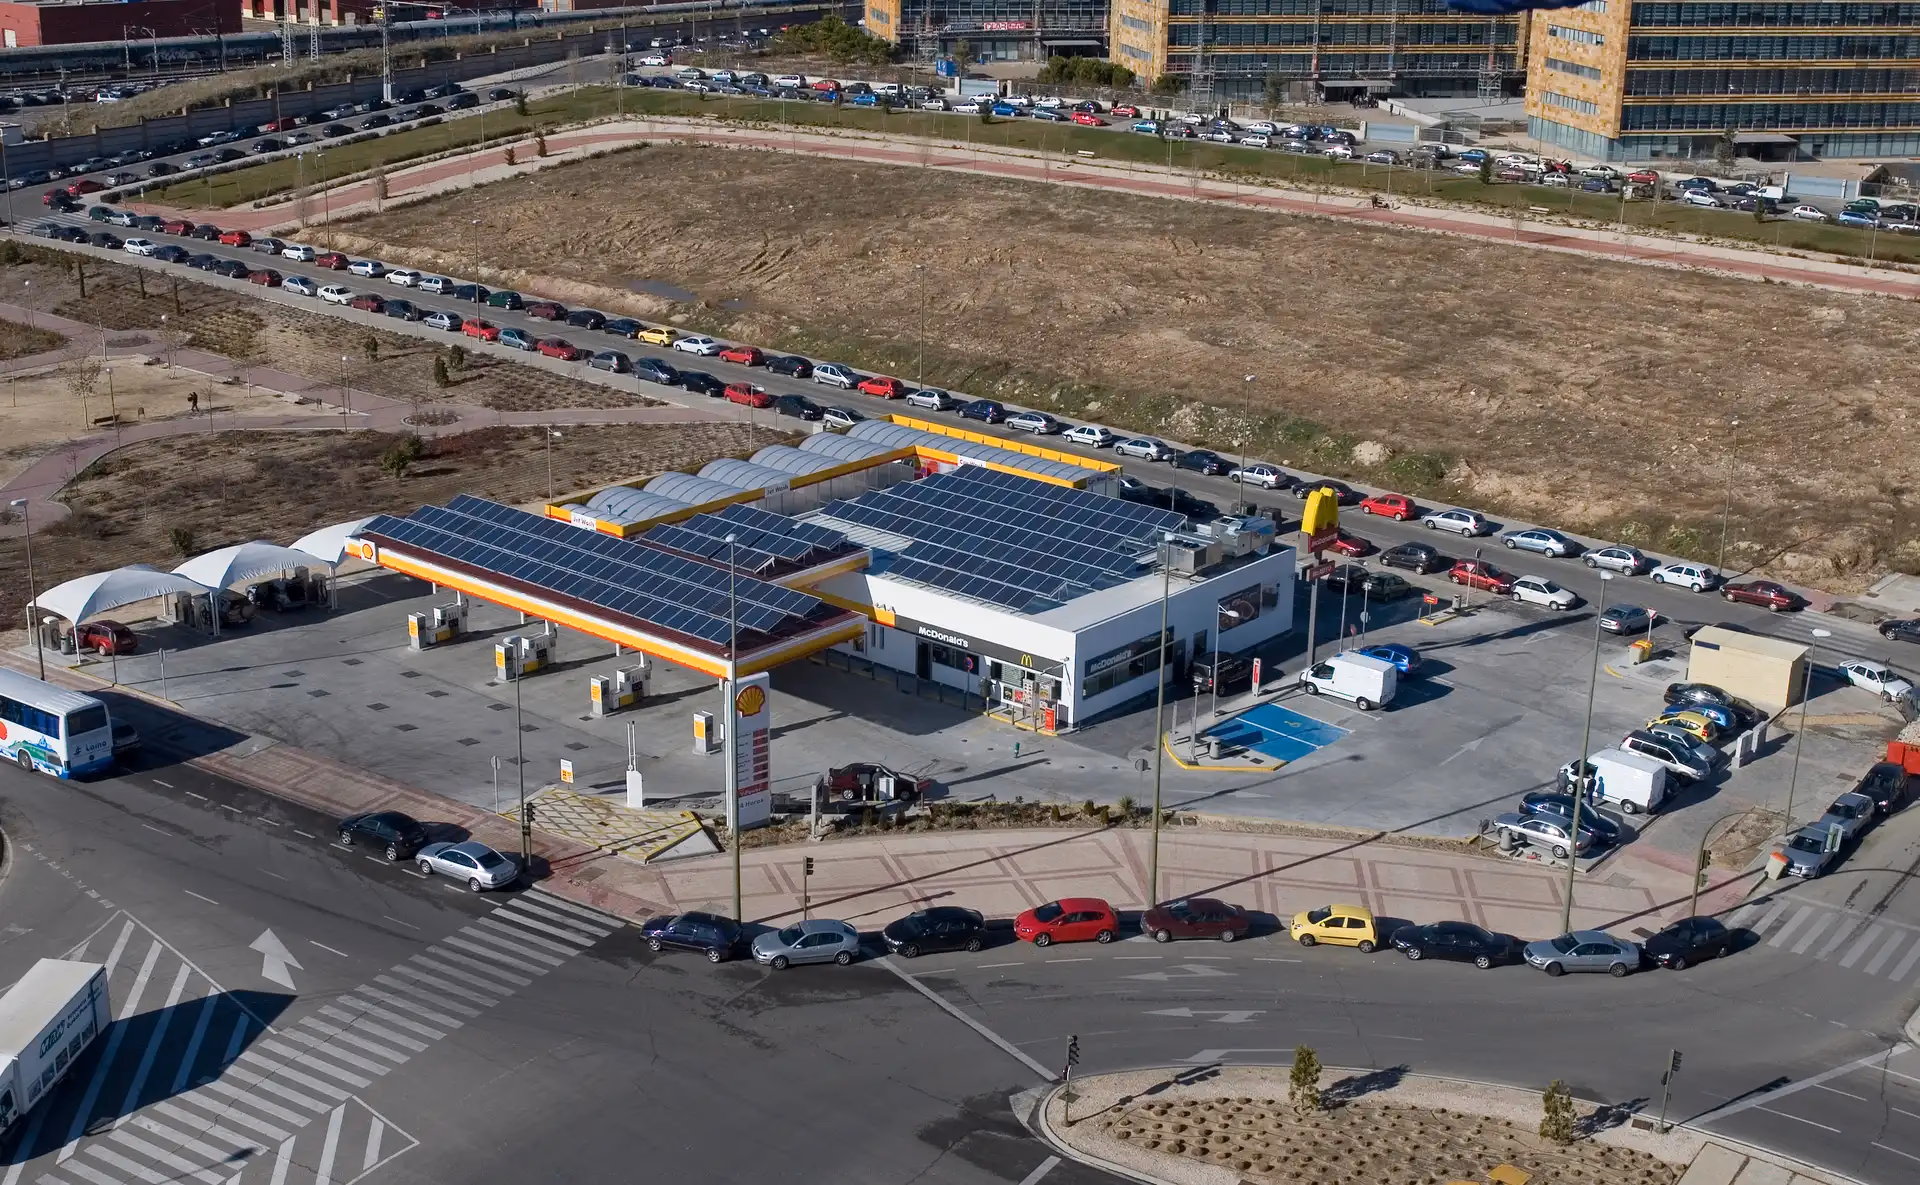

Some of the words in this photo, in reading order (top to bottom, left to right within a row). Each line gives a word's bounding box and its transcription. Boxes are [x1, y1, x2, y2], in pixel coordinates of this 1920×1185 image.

[918, 626, 968, 648] McDonald's
[1091, 650, 1132, 673] McDonald's
[745, 798, 764, 807] Horas
